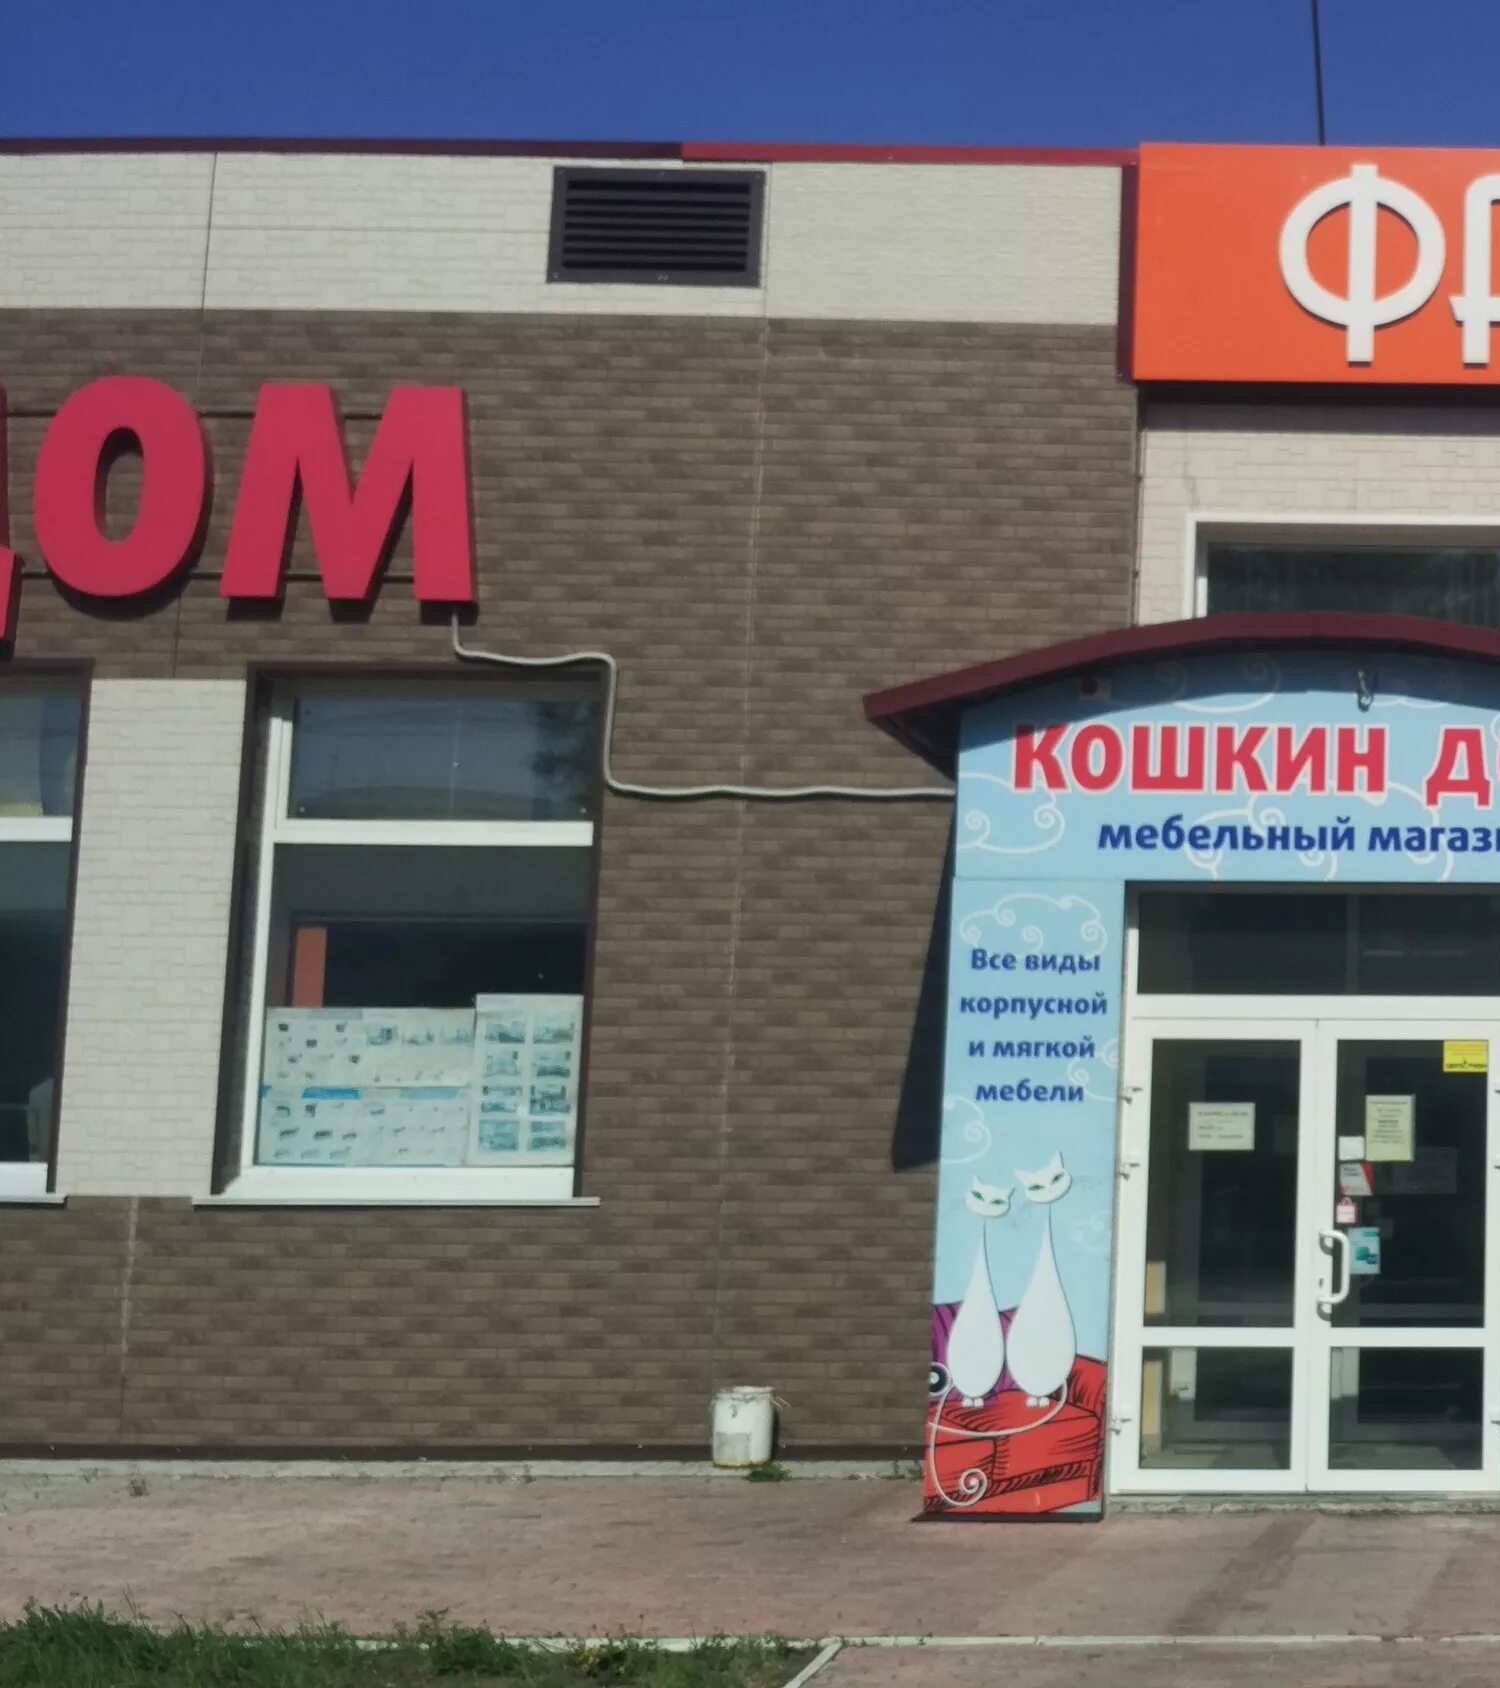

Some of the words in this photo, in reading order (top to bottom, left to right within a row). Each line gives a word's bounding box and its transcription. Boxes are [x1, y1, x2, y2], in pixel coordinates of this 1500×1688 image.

[0, 375, 480, 640] ОМ
[1014, 724, 1387, 794] КОШКИН
[1098, 814, 1356, 854] мебельный
[970, 948, 1017, 970] Все
[1024, 953, 1101, 975] виды
[959, 991, 1108, 1020] корпусной
[968, 1040, 985, 1057] и
[992, 1034, 1096, 1058] мягкой
[975, 1078, 1085, 1102] мебели
